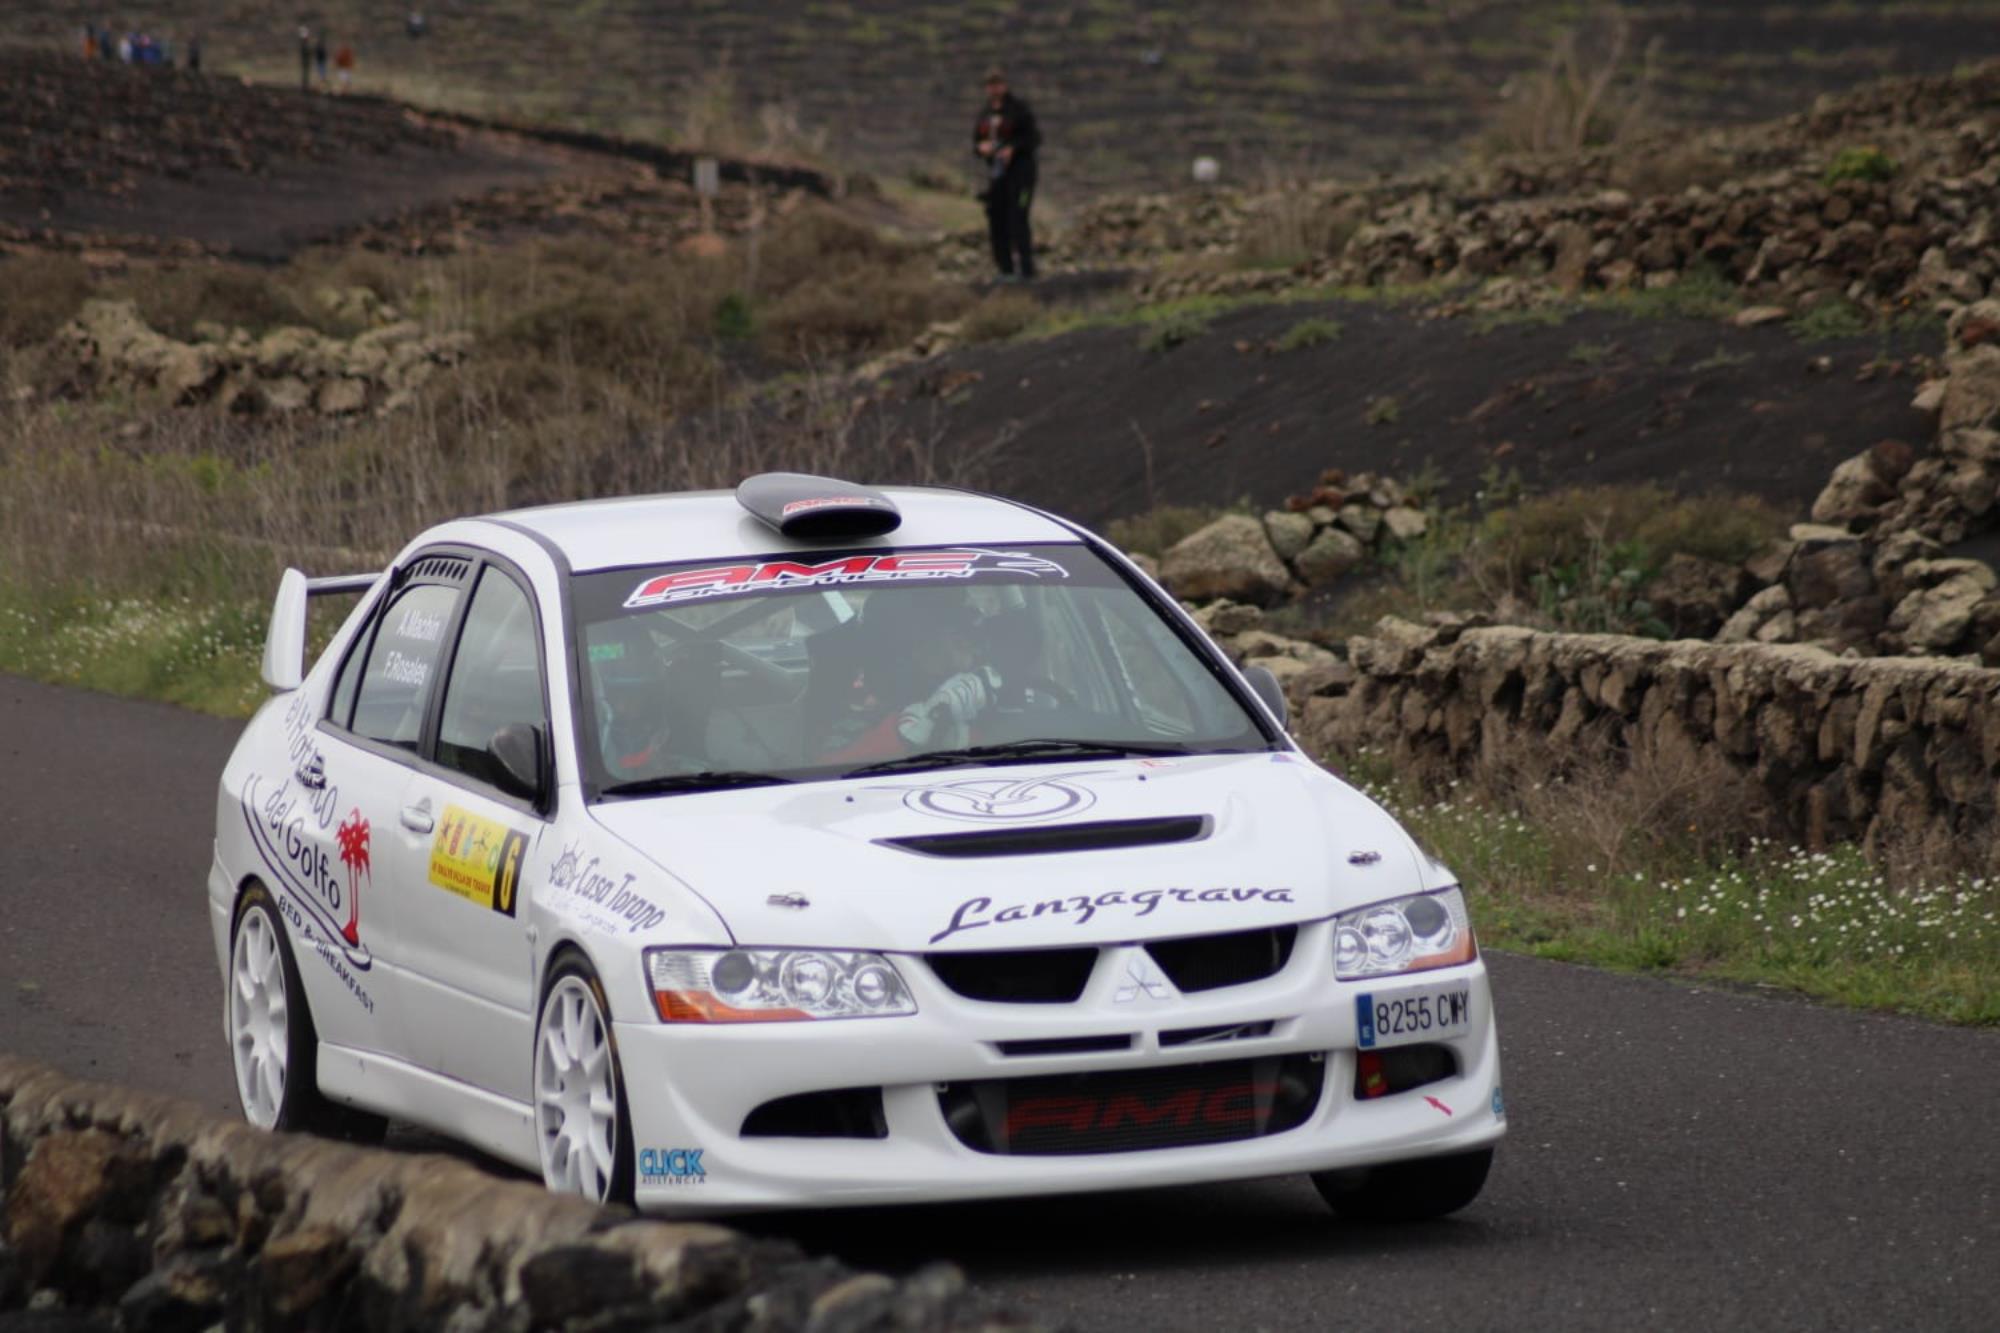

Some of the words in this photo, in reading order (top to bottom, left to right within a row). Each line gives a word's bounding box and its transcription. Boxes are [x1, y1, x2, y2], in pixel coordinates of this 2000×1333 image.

[629, 552, 981, 600] AMC
[264, 779, 297, 840] del
[286, 817, 341, 910] Golfo
[500, 835, 523, 912] 6
[575, 856, 615, 904] Casa
[279, 895, 302, 928] BED
[928, 887, 1295, 945] Lanzagrava
[1376, 996, 1432, 1036] 8255
[996, 1082, 1281, 1137] AMC
[639, 1148, 705, 1175] CLICK
